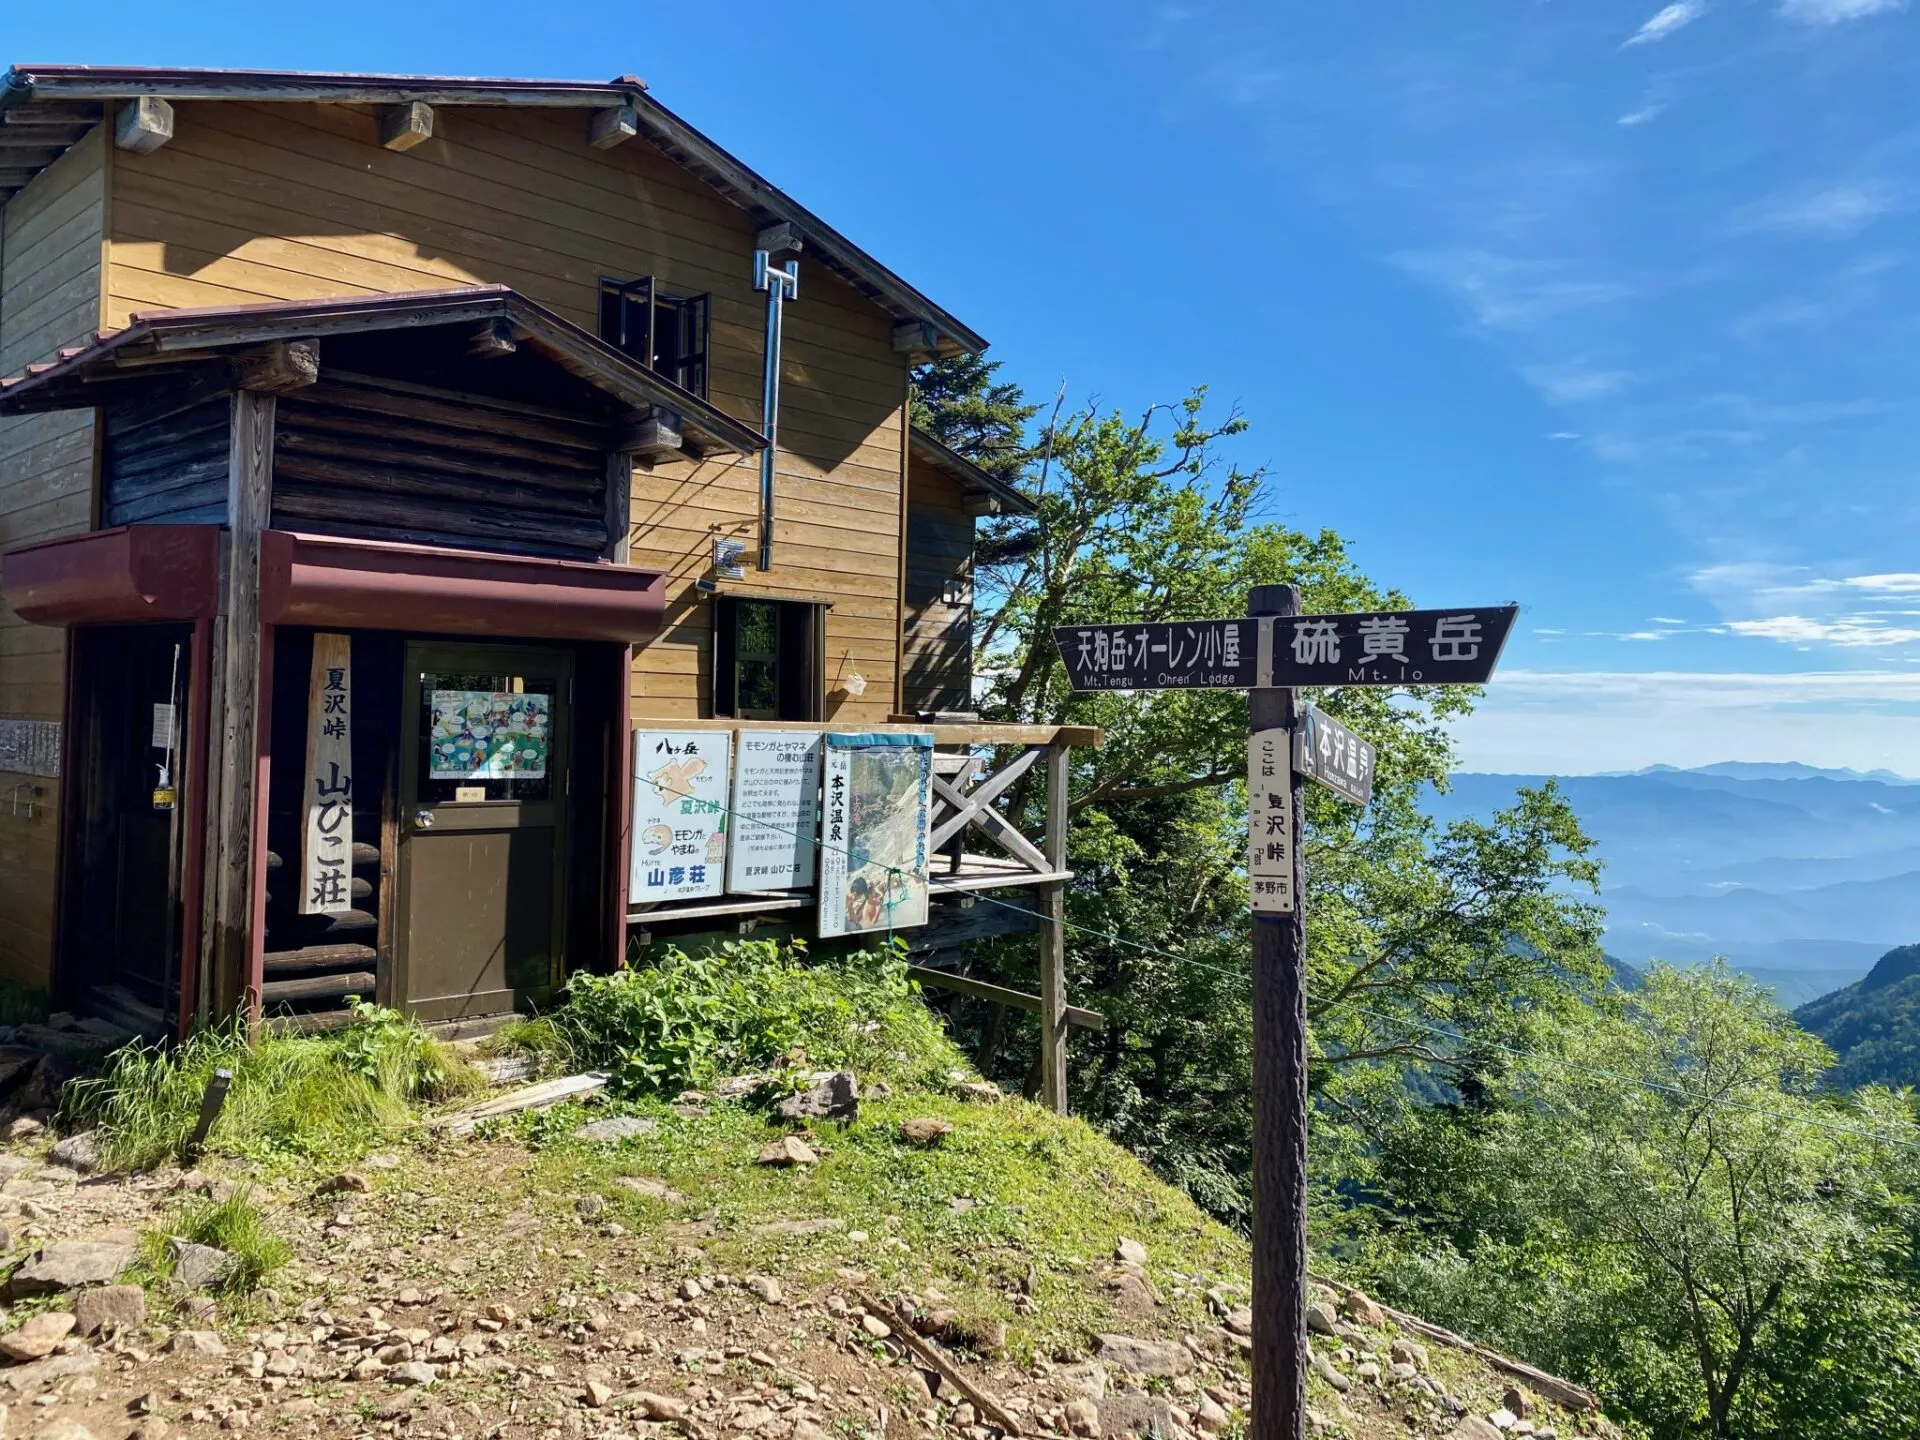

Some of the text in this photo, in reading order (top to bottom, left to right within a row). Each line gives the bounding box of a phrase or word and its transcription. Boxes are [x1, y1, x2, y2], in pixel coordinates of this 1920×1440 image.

[1076, 623, 1240, 673] 天狗岳・オーレン小屋
[1290, 614, 1483, 665] 硫黄岳
[1158, 671, 1190, 686] Ohren
[1200, 670, 1235, 685] Lodge
[1348, 667, 1388, 682] Mt.
[745, 741, 807, 752] モモンガとヤマネ
[1262, 740, 1275, 777] ここは
[310, 667, 351, 905] 夏沢峠 山びこ荘
[679, 799, 721, 816] 夏沢峠
[829, 774, 844, 842] 本沢温泉
[674, 829, 707, 842] モモンガと
[647, 864, 706, 887] 山彦荘
[745, 866, 769, 877] 夏沢峠
[1253, 881, 1288, 895] 茅野市
